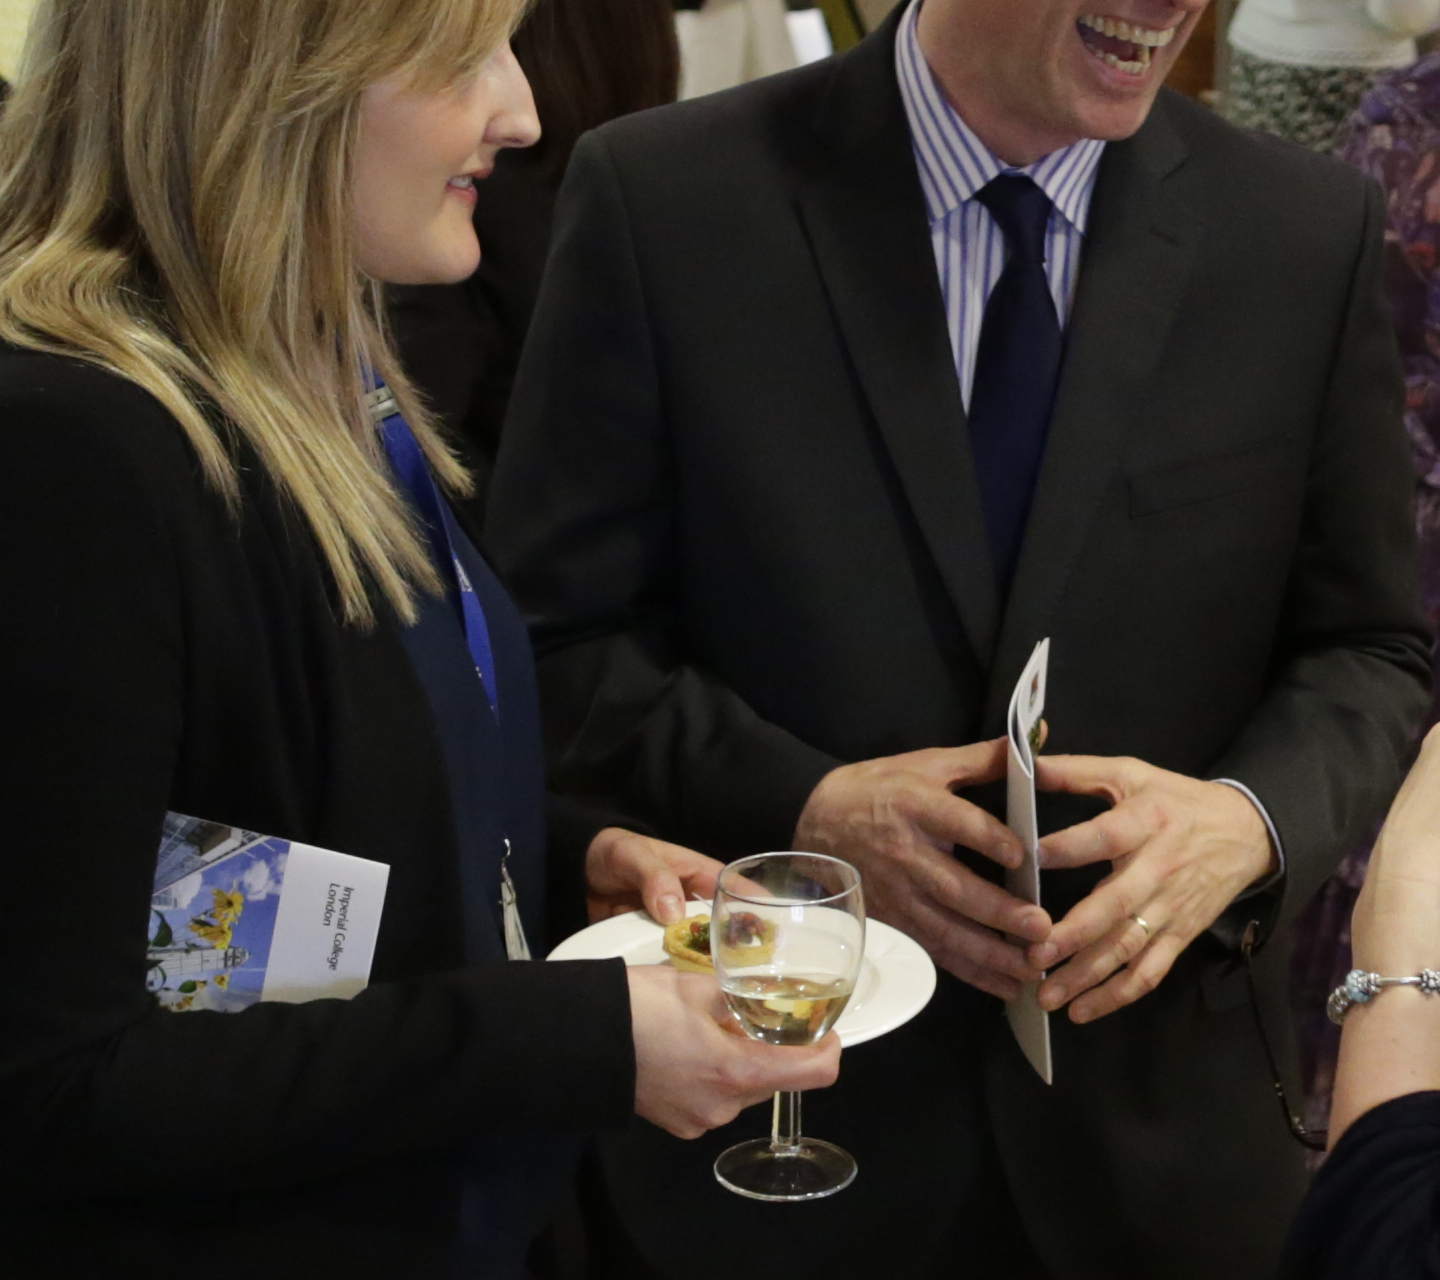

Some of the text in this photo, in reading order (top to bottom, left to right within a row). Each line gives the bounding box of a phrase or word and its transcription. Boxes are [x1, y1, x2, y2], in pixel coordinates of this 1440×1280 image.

[323, 883, 340, 926] London
[326, 886, 354, 971] Imperial College
